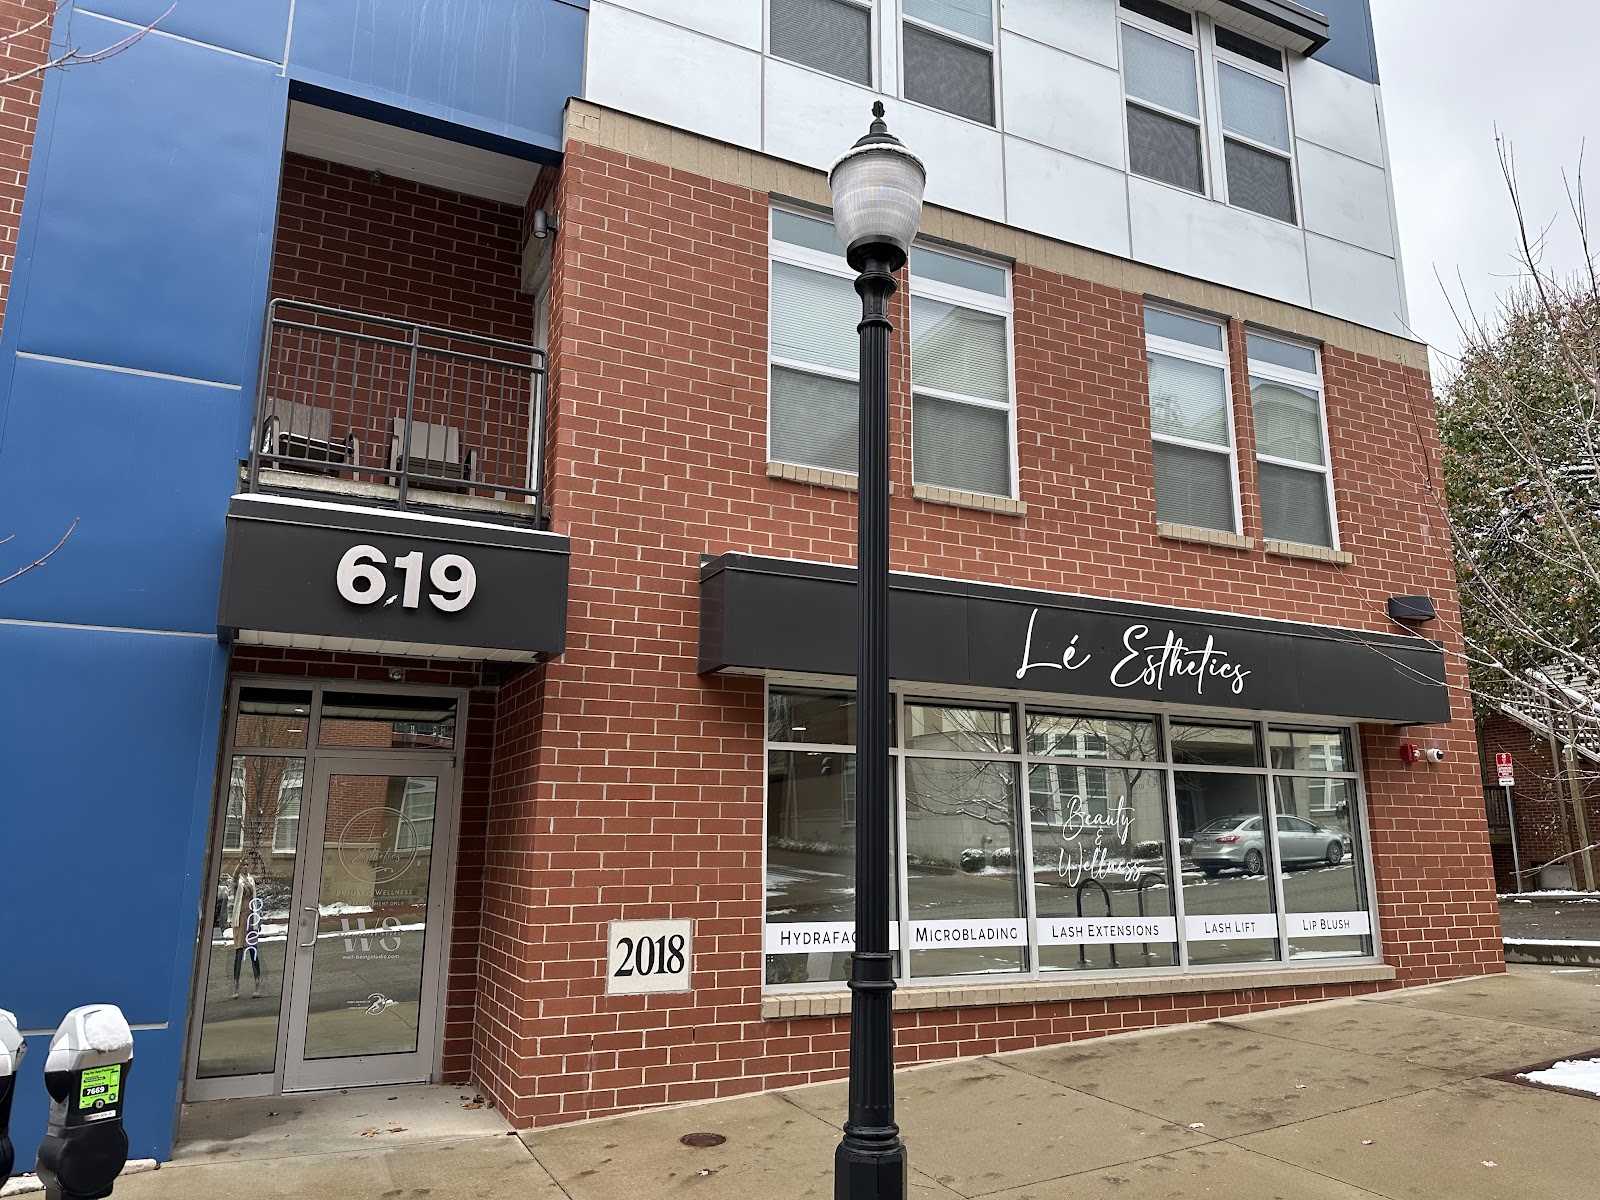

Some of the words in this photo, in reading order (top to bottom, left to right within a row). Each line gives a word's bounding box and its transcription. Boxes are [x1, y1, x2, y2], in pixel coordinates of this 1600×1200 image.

[336, 544, 477, 612] 619
[1016, 608, 1091, 679] Lé
[1110, 624, 1251, 694] Esthetics
[1063, 795, 1135, 845] Beauty
[1058, 841, 1144, 888] Wellness
[374, 889, 413, 897] WELLNESS
[1052, 925, 1083, 938] LASH
[1087, 924, 1160, 937] EXTENSIONS
[1204, 921, 1232, 934] LASH
[1235, 920, 1256, 933] LIFT
[1320, 918, 1350, 930] BLUSH
[915, 927, 1018, 943] MICROBLADING
[613, 934, 685, 977] 2018
[86, 1086, 105, 1096] 7669
